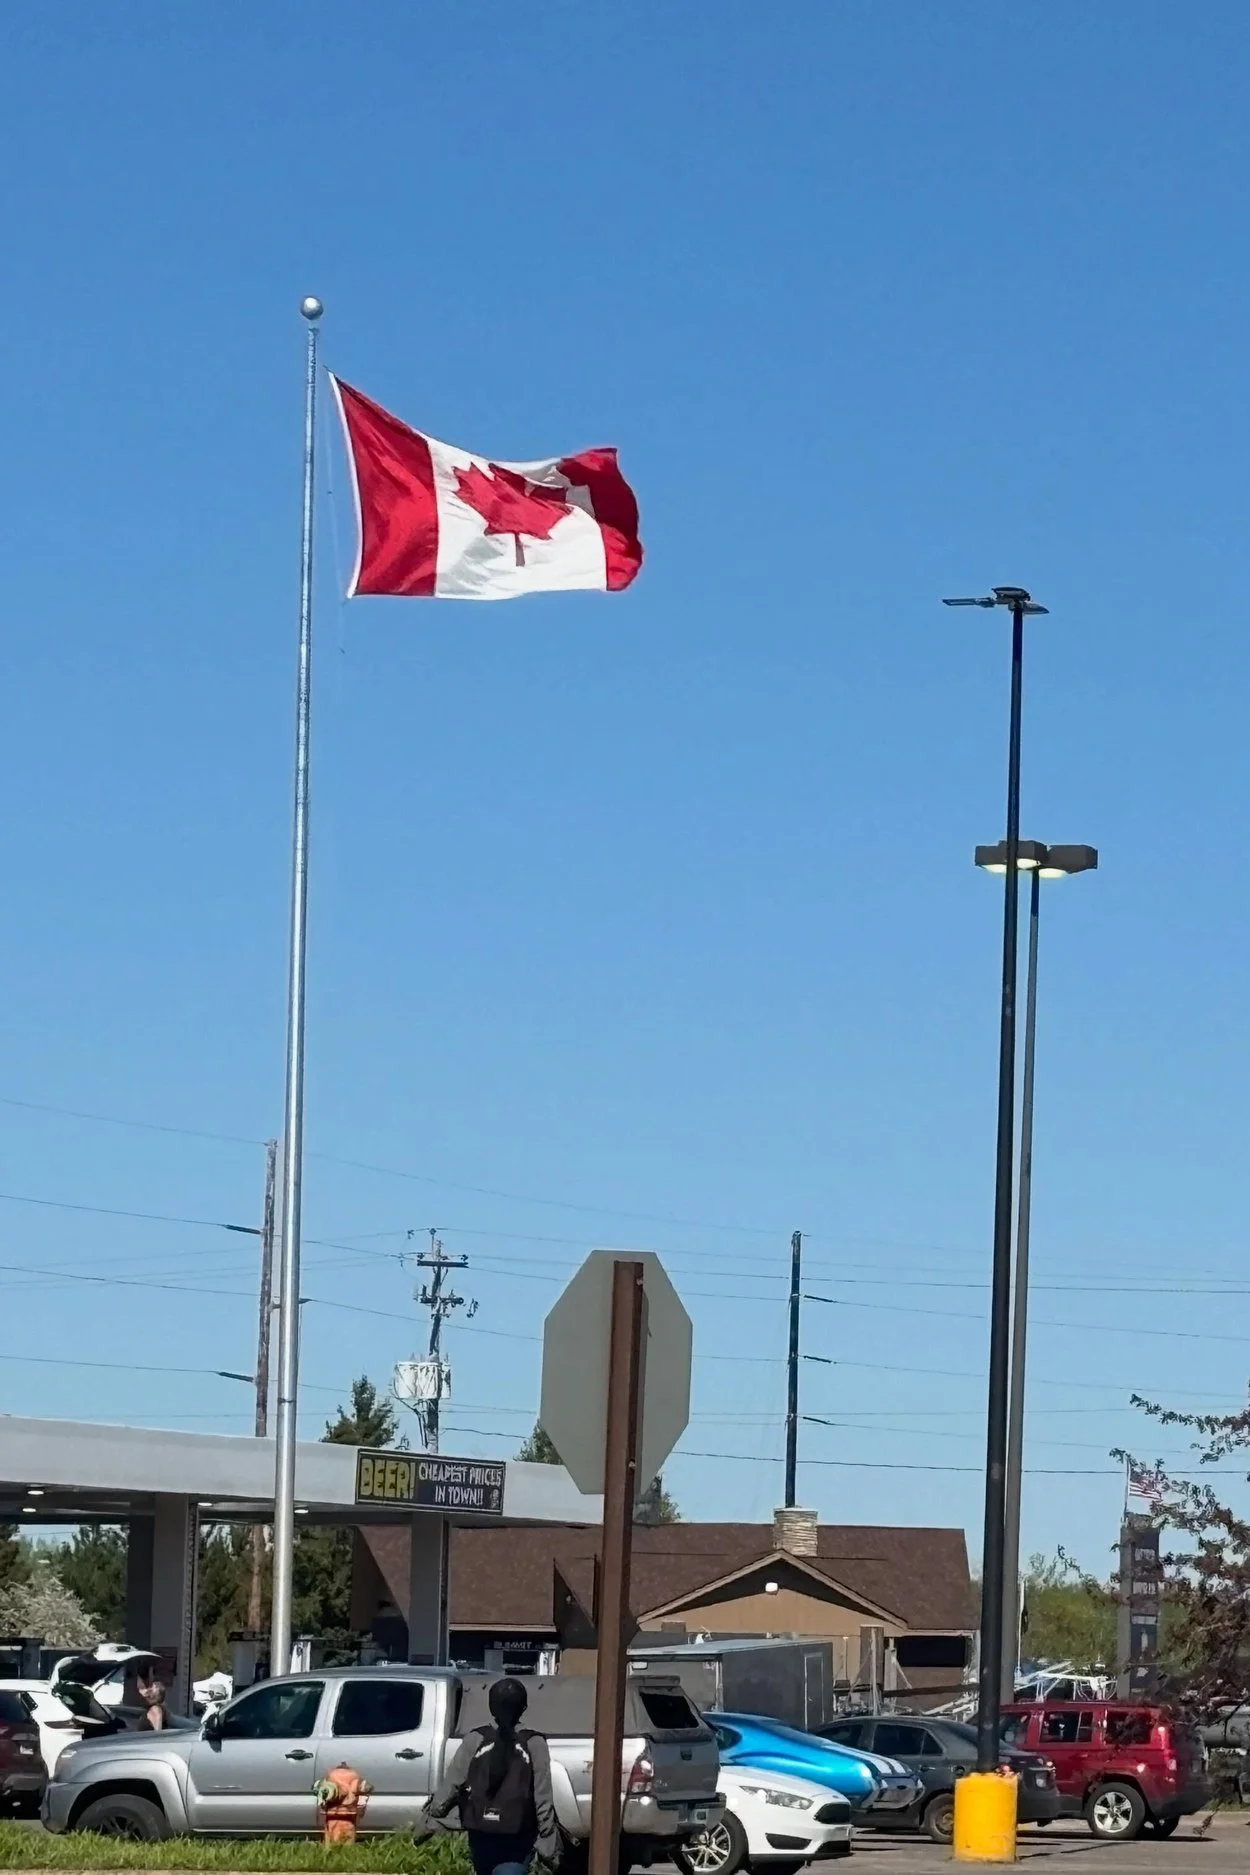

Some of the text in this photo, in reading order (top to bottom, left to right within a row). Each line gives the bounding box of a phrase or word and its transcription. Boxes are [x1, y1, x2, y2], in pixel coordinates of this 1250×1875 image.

[360, 1458, 416, 1499] BEER!
[418, 1461, 502, 1487] CHEAPEST PRICES
[434, 1485, 446, 1503] IN
